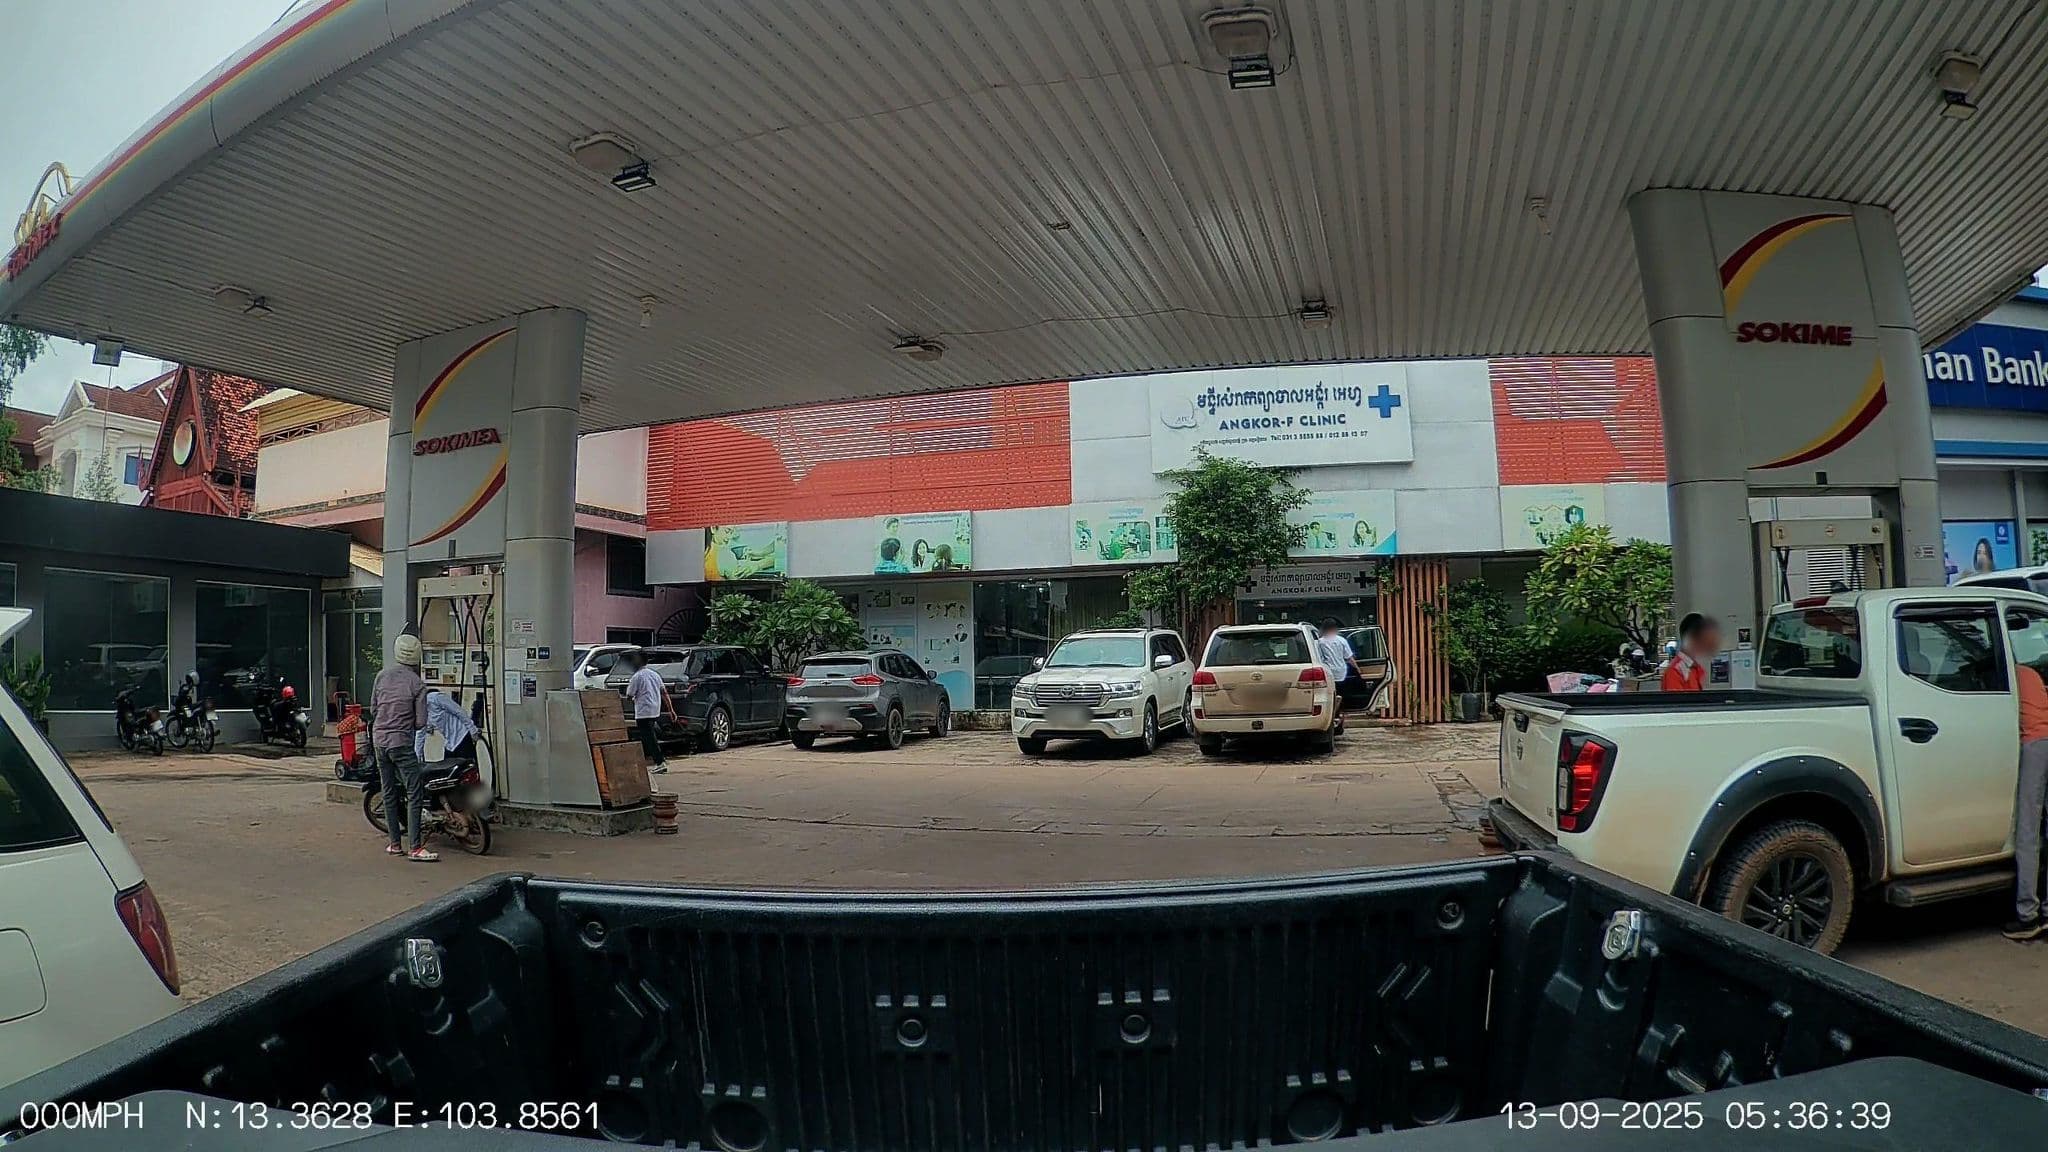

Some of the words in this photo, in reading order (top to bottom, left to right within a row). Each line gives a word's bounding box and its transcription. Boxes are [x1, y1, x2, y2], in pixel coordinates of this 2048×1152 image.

[1736, 322, 1852, 346] SOKIME
[1981, 346, 2048, 387] Bank
[1219, 416, 1294, 431] ANGKOR-F
[1299, 413, 1347, 427] CLINIC
[1271, 586, 1313, 594] ANGKOR-F
